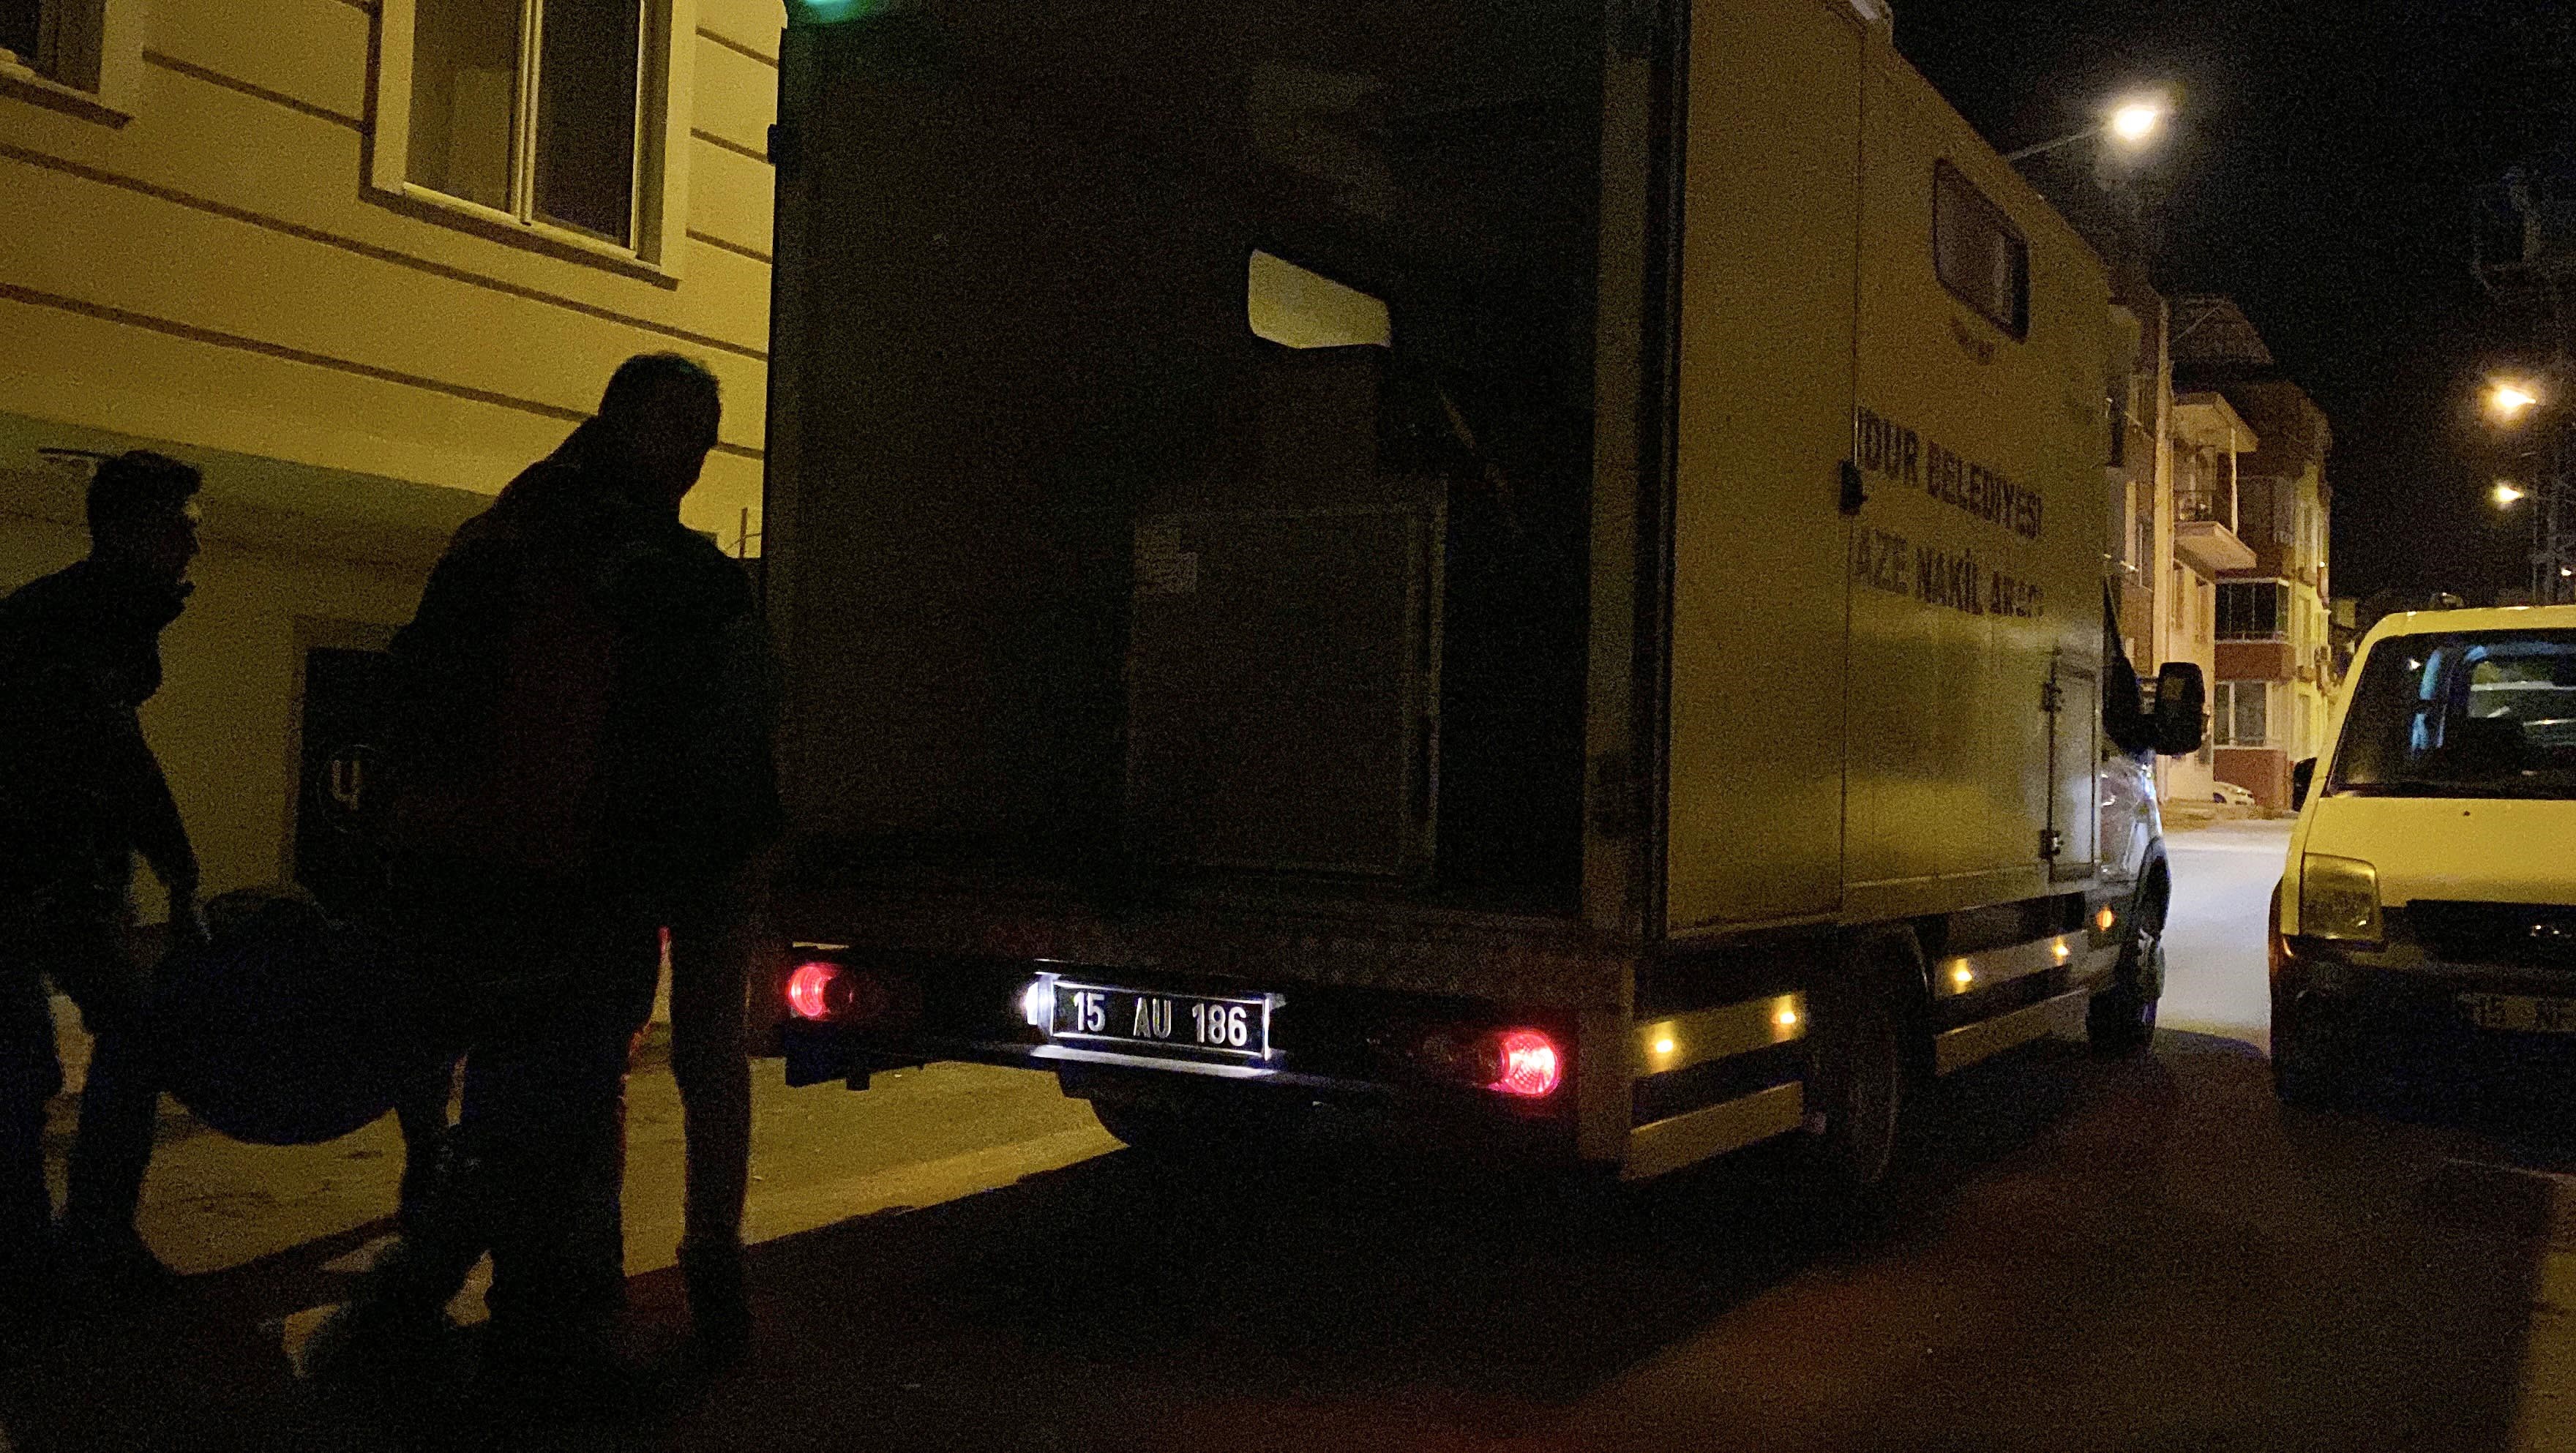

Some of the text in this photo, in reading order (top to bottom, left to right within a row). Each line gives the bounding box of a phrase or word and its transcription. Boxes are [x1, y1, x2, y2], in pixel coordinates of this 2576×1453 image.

[1073, 991, 1248, 1048] 15 AU 186
